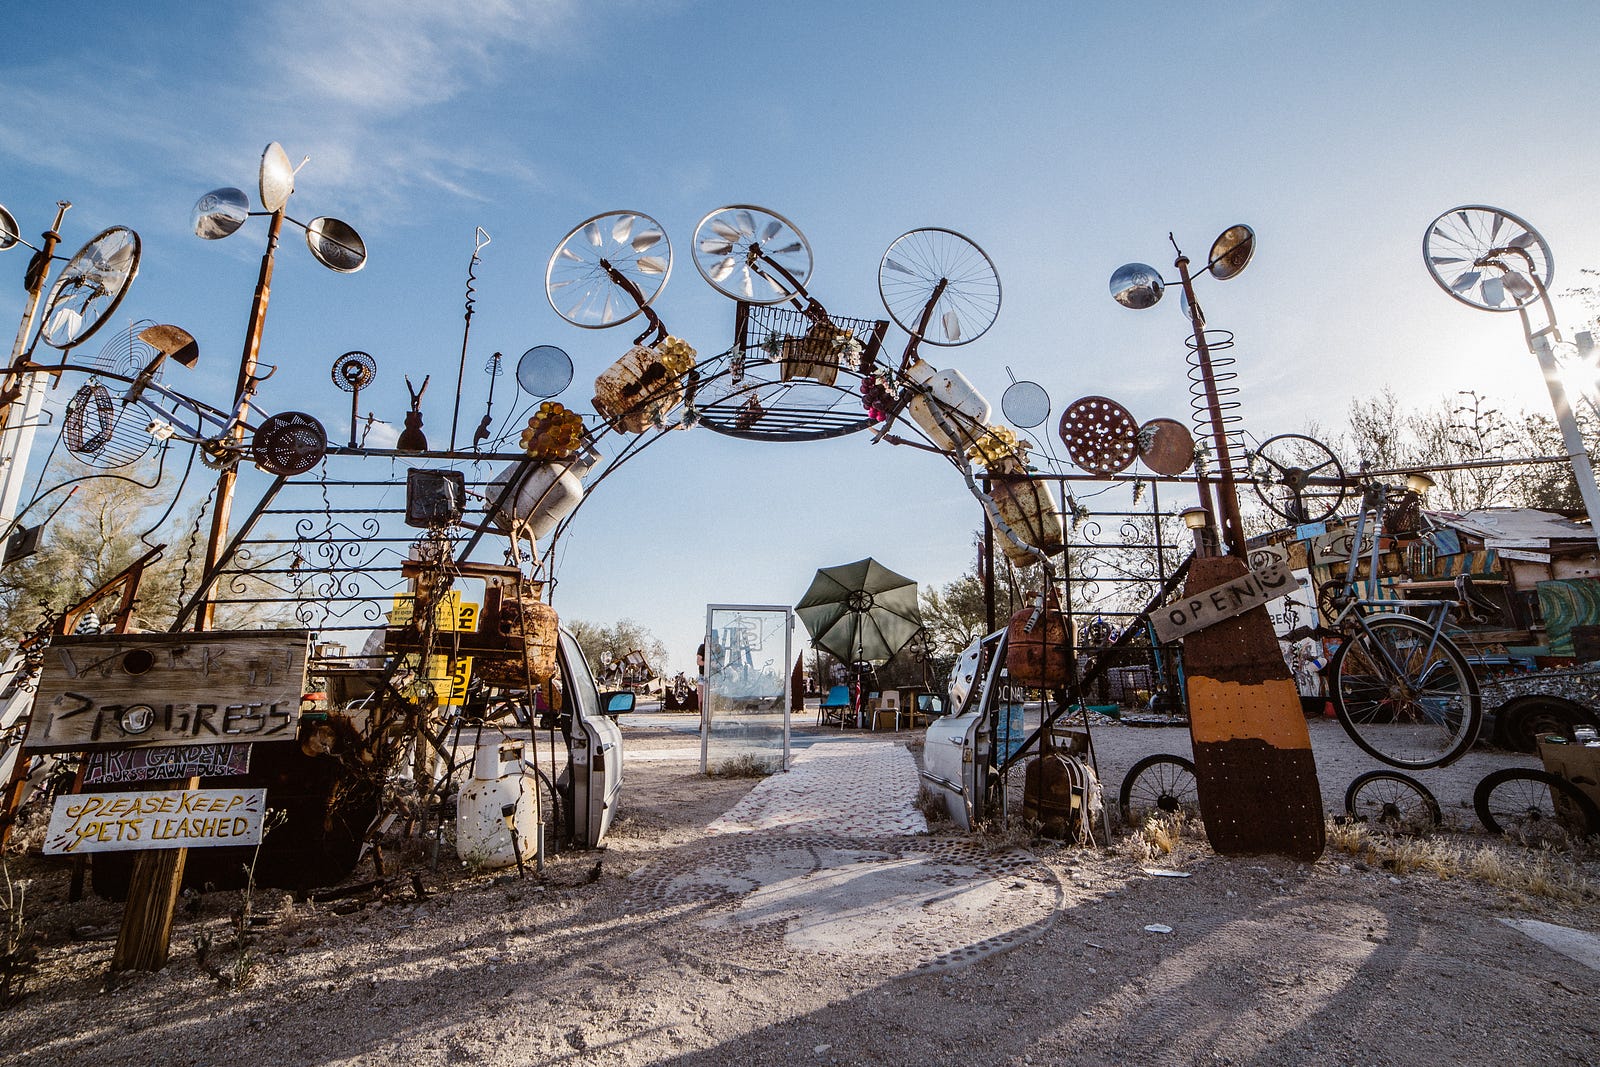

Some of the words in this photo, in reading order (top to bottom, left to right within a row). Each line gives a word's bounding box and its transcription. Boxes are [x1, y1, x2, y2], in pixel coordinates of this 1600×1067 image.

[83, 749, 137, 784] ART
[145, 744, 233, 767] GARDEN
[65, 797, 174, 833] PLEASE
[174, 792, 244, 814] KEEP
[63, 817, 144, 852] PETS
